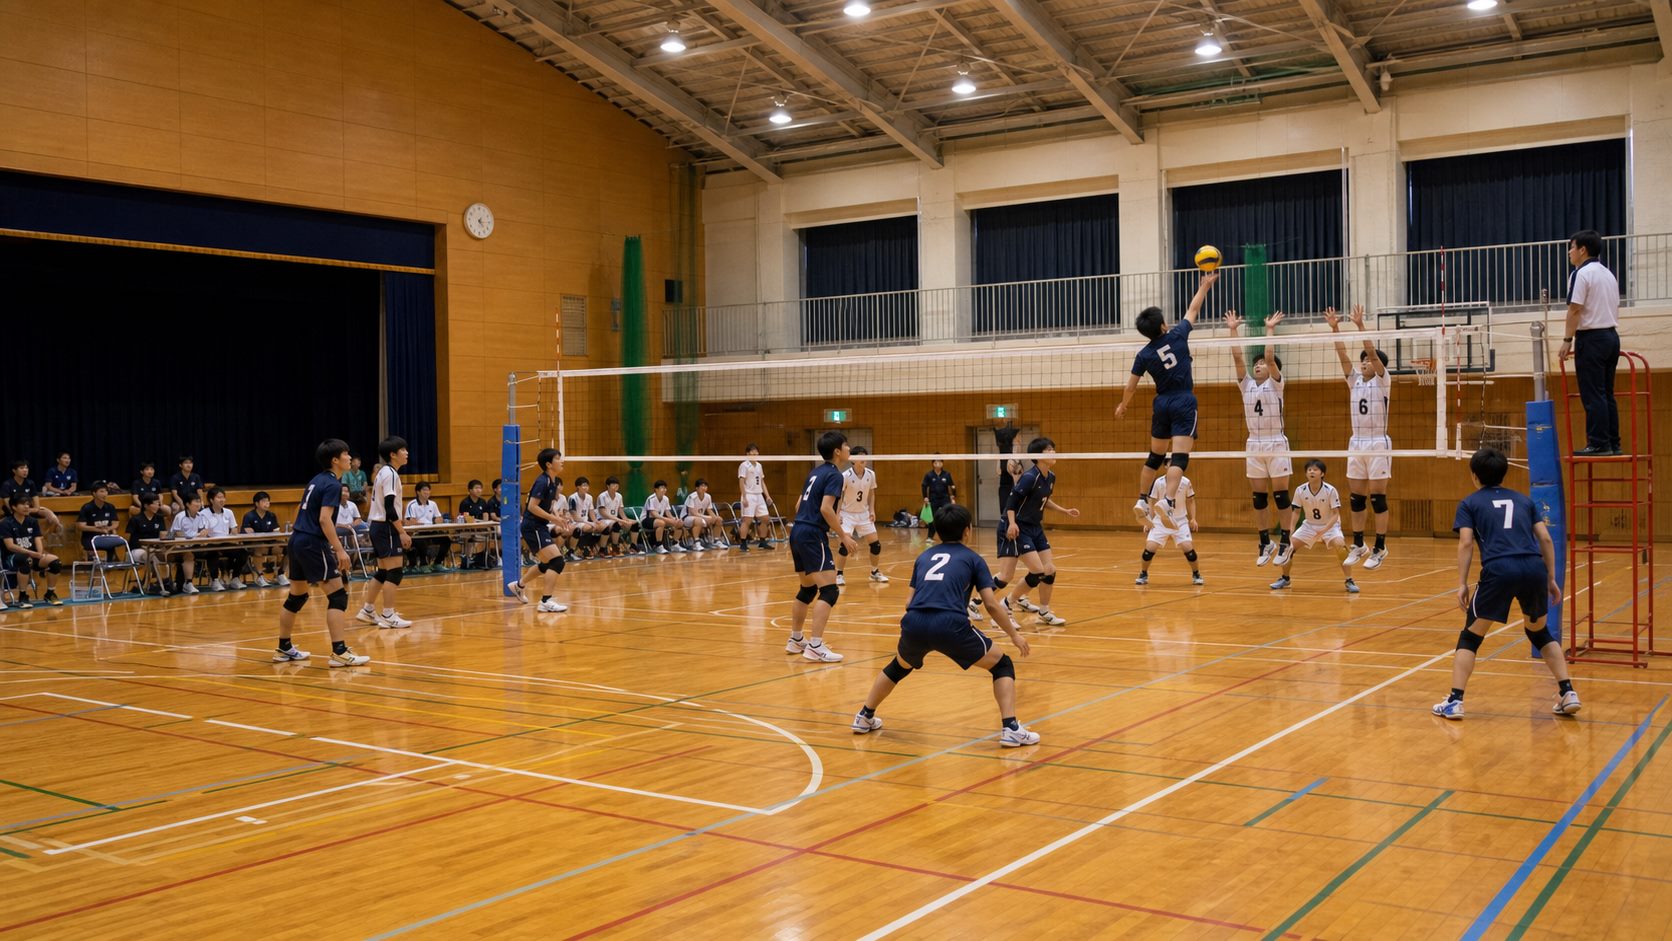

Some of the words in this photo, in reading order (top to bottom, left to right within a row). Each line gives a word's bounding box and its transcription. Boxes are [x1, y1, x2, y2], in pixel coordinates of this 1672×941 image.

[1157, 344, 1178, 370] 5
[1254, 399, 1264, 416] 4
[1358, 398, 1369, 415] 6
[856, 490, 864, 502] 3
[1312, 508, 1322, 520] 8
[1491, 500, 1514, 529] 7
[924, 552, 951, 581] 2
